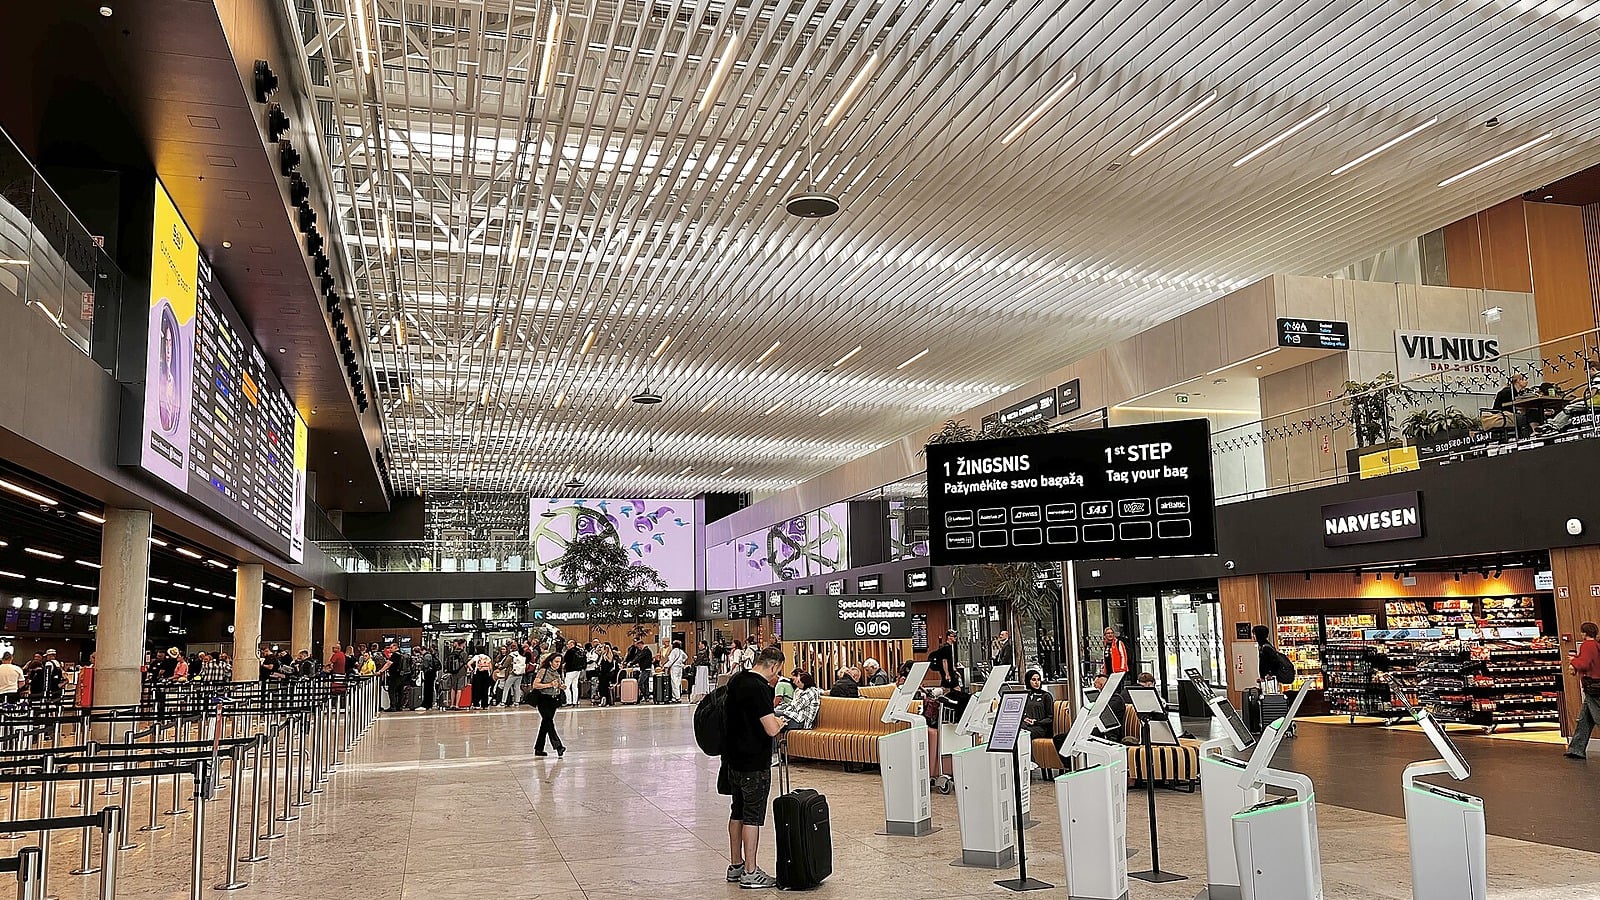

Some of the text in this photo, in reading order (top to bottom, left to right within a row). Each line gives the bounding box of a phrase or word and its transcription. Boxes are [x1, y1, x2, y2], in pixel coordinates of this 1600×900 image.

[1401, 335, 1500, 362] VILNIUS
[1431, 363, 1450, 371] BAR
[1464, 364, 1499, 373] BISTRO
[1105, 443, 1173, 463] 1st STEP
[944, 455, 1030, 476] 1 ŽINGSNIS
[1106, 465, 1189, 484] Tag your bag
[944, 472, 1084, 495] Pažymėkite savo bagažą
[1086, 505, 1109, 515] SAS
[1325, 507, 1416, 535] NARVESEN
[648, 597, 659, 605] All
[660, 597, 683, 607] gates
[838, 600, 875, 609] Specialioji
[546, 611, 585, 622] Saugumo
[838, 610, 906, 619] Special Assistance
